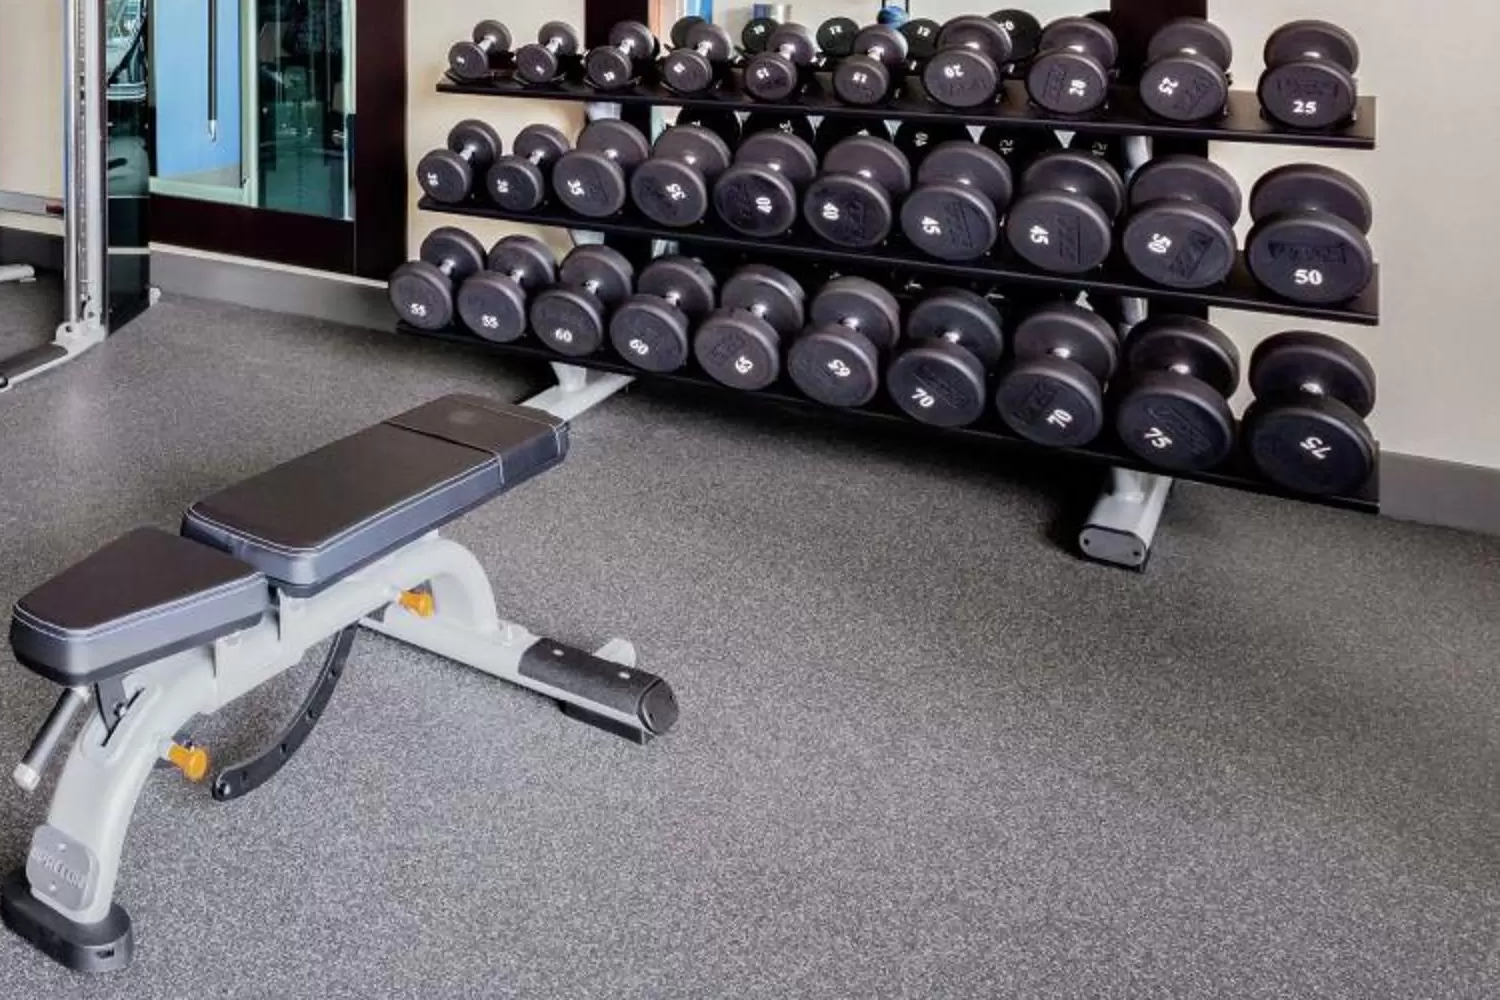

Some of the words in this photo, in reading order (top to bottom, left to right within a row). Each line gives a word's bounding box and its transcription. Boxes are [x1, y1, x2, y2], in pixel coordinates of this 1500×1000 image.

[943, 64, 964, 80] 20
[1157, 76, 1179, 96] 25
[1292, 100, 1317, 115] 25
[665, 182, 687, 201] 35
[755, 196, 773, 215] 40
[821, 202, 841, 222] 40
[921, 215, 942, 236] 45
[1029, 224, 1050, 246] 45
[1147, 232, 1173, 254] 50
[1294, 269, 1324, 286] 50
[410, 302, 427, 318] 55
[481, 313, 500, 330] 55
[555, 327, 574, 343] 60
[629, 337, 649, 356] 60
[734, 355, 754, 375] 65
[911, 386, 936, 409] 70
[1045, 408, 1074, 430] 70
[1143, 426, 1174, 450] 75
[1300, 435, 1333, 461] 75
